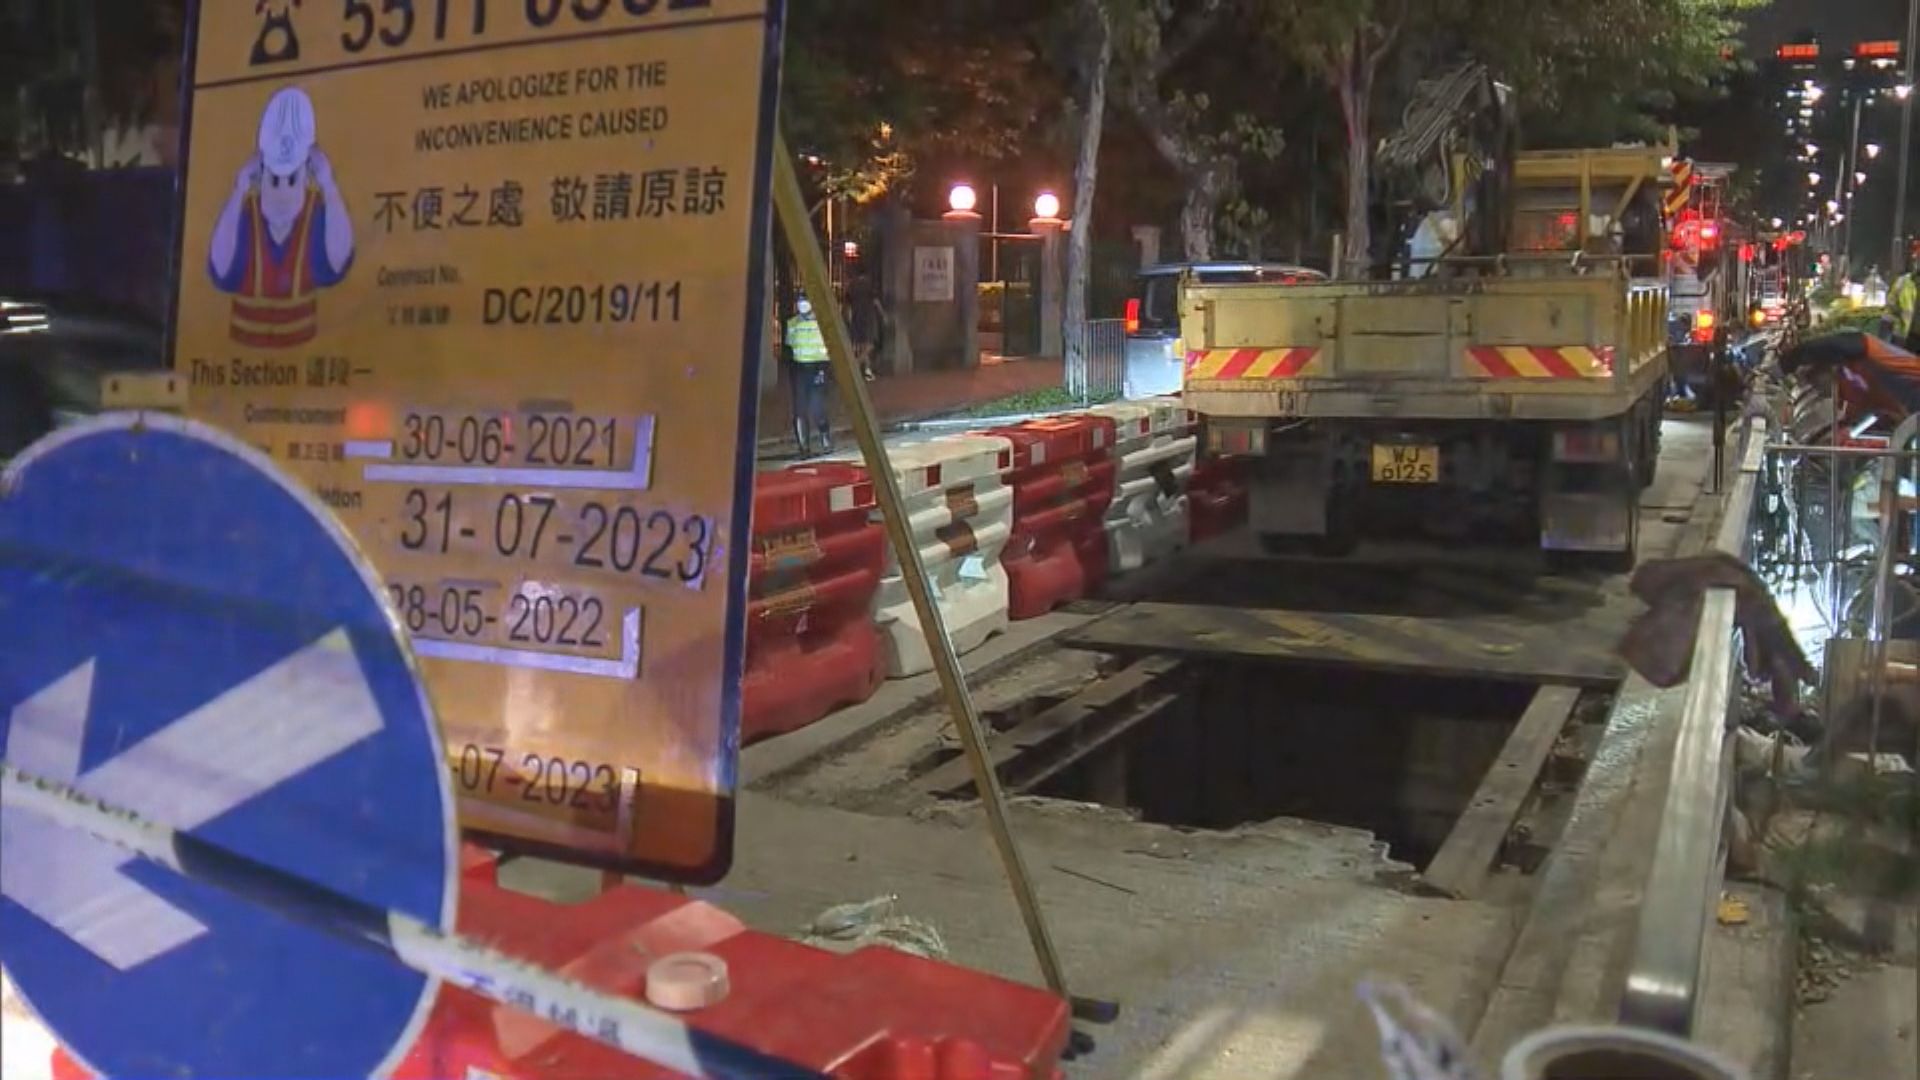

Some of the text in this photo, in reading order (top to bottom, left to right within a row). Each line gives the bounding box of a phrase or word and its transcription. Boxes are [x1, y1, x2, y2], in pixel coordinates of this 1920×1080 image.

[422, 60, 668, 110] WE APOLOGIZE FOR THE
[415, 105, 669, 151] INCONVENIENCE CAUSED
[373, 165, 728, 234] 不便之處 敬請原諒
[482, 281, 683, 325] DC/2019/11
[190, 358, 225, 387] This
[230, 357, 298, 387] Section
[1381, 463, 1432, 480] 6125
[1392, 447, 1420, 463] WJ
